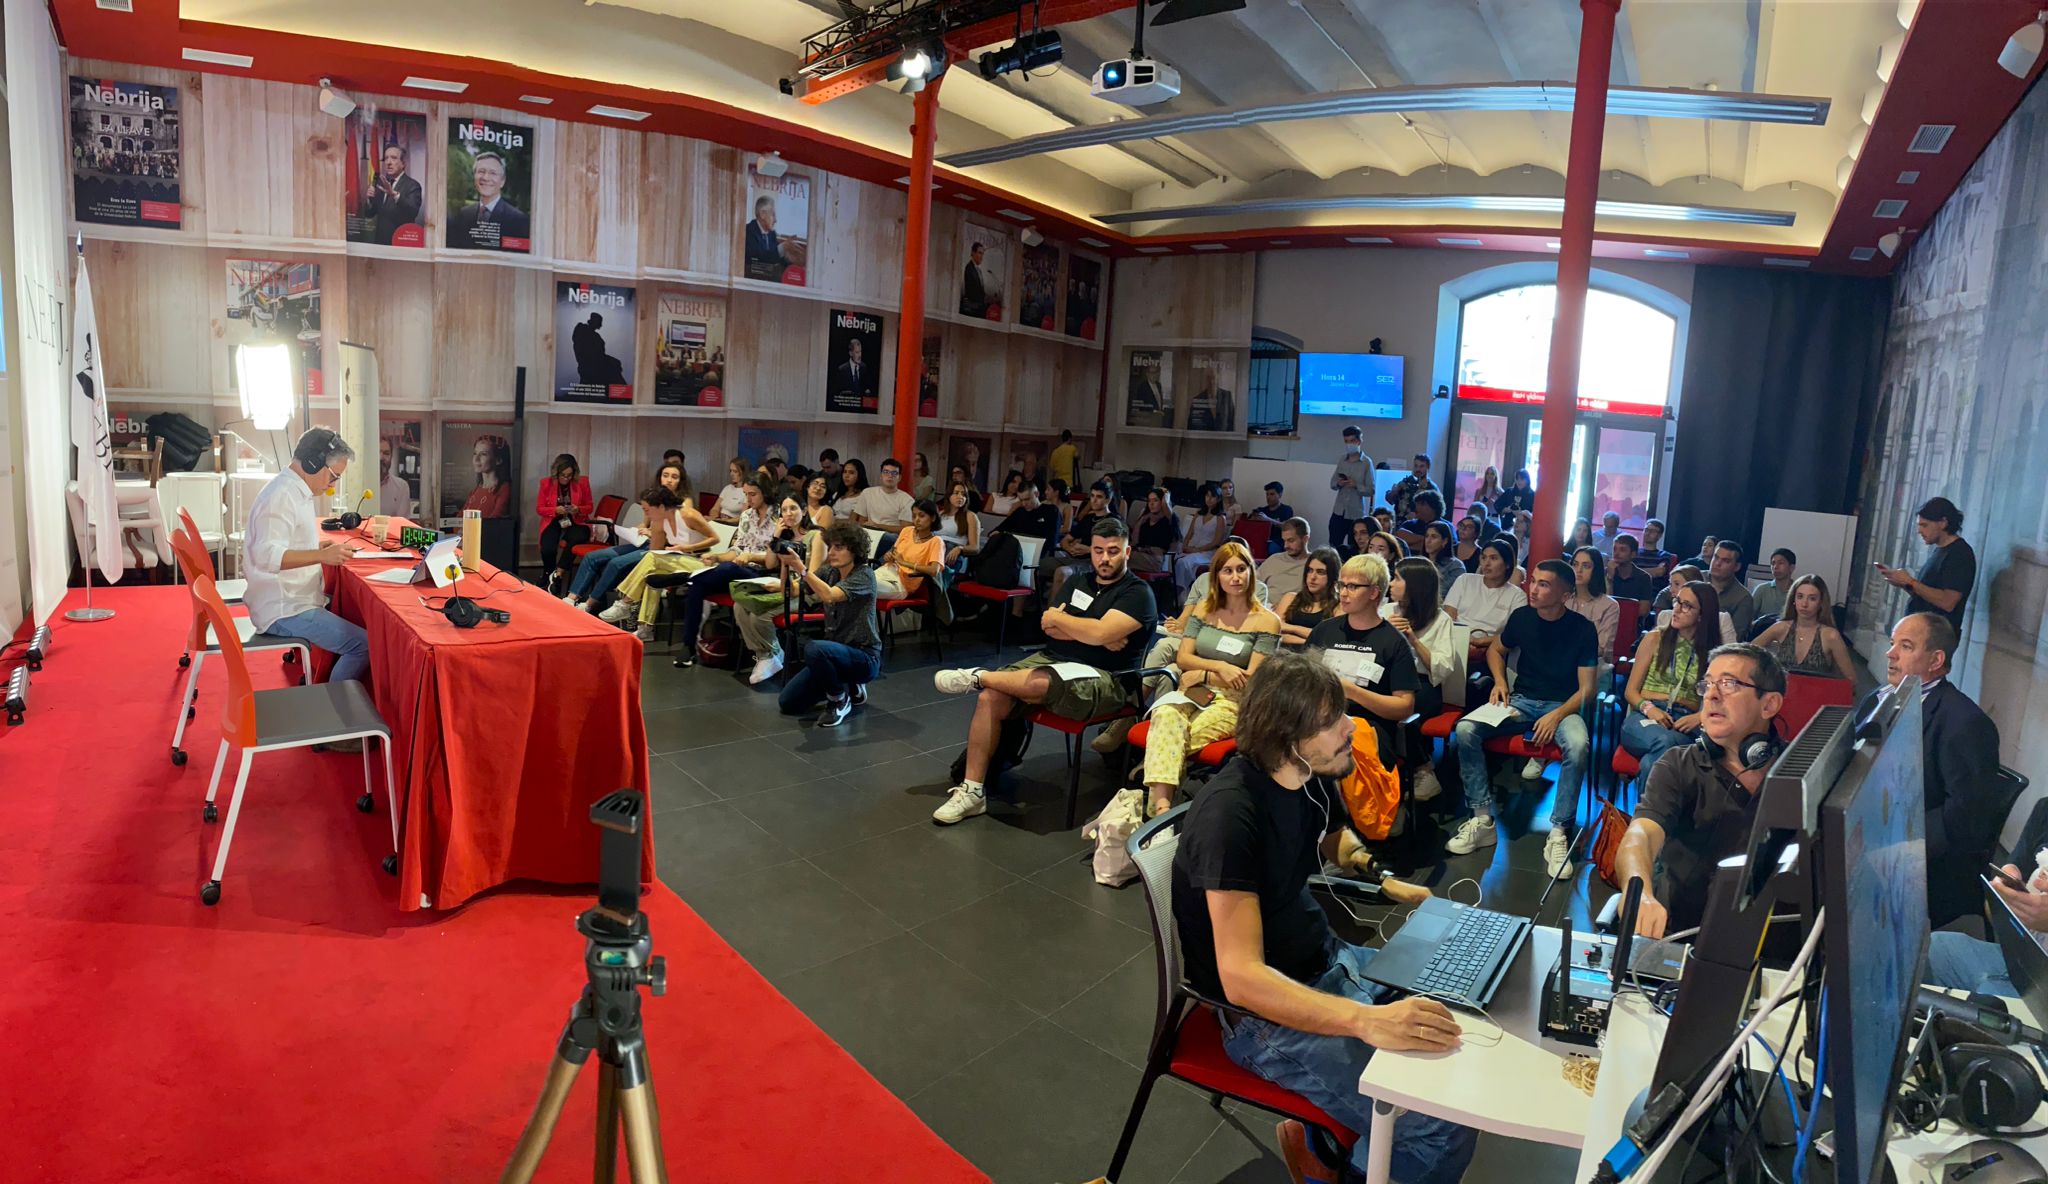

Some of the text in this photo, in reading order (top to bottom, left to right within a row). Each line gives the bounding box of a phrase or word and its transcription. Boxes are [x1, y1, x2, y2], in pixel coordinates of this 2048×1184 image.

[84, 84, 164, 112] Nebrija
[459, 123, 523, 149] Nebrija
[751, 174, 806, 200] NEBRIJA
[568, 287, 625, 309] Nebrija
[661, 297, 723, 321] NEBRIJA
[837, 314, 876, 334] Nebrija
